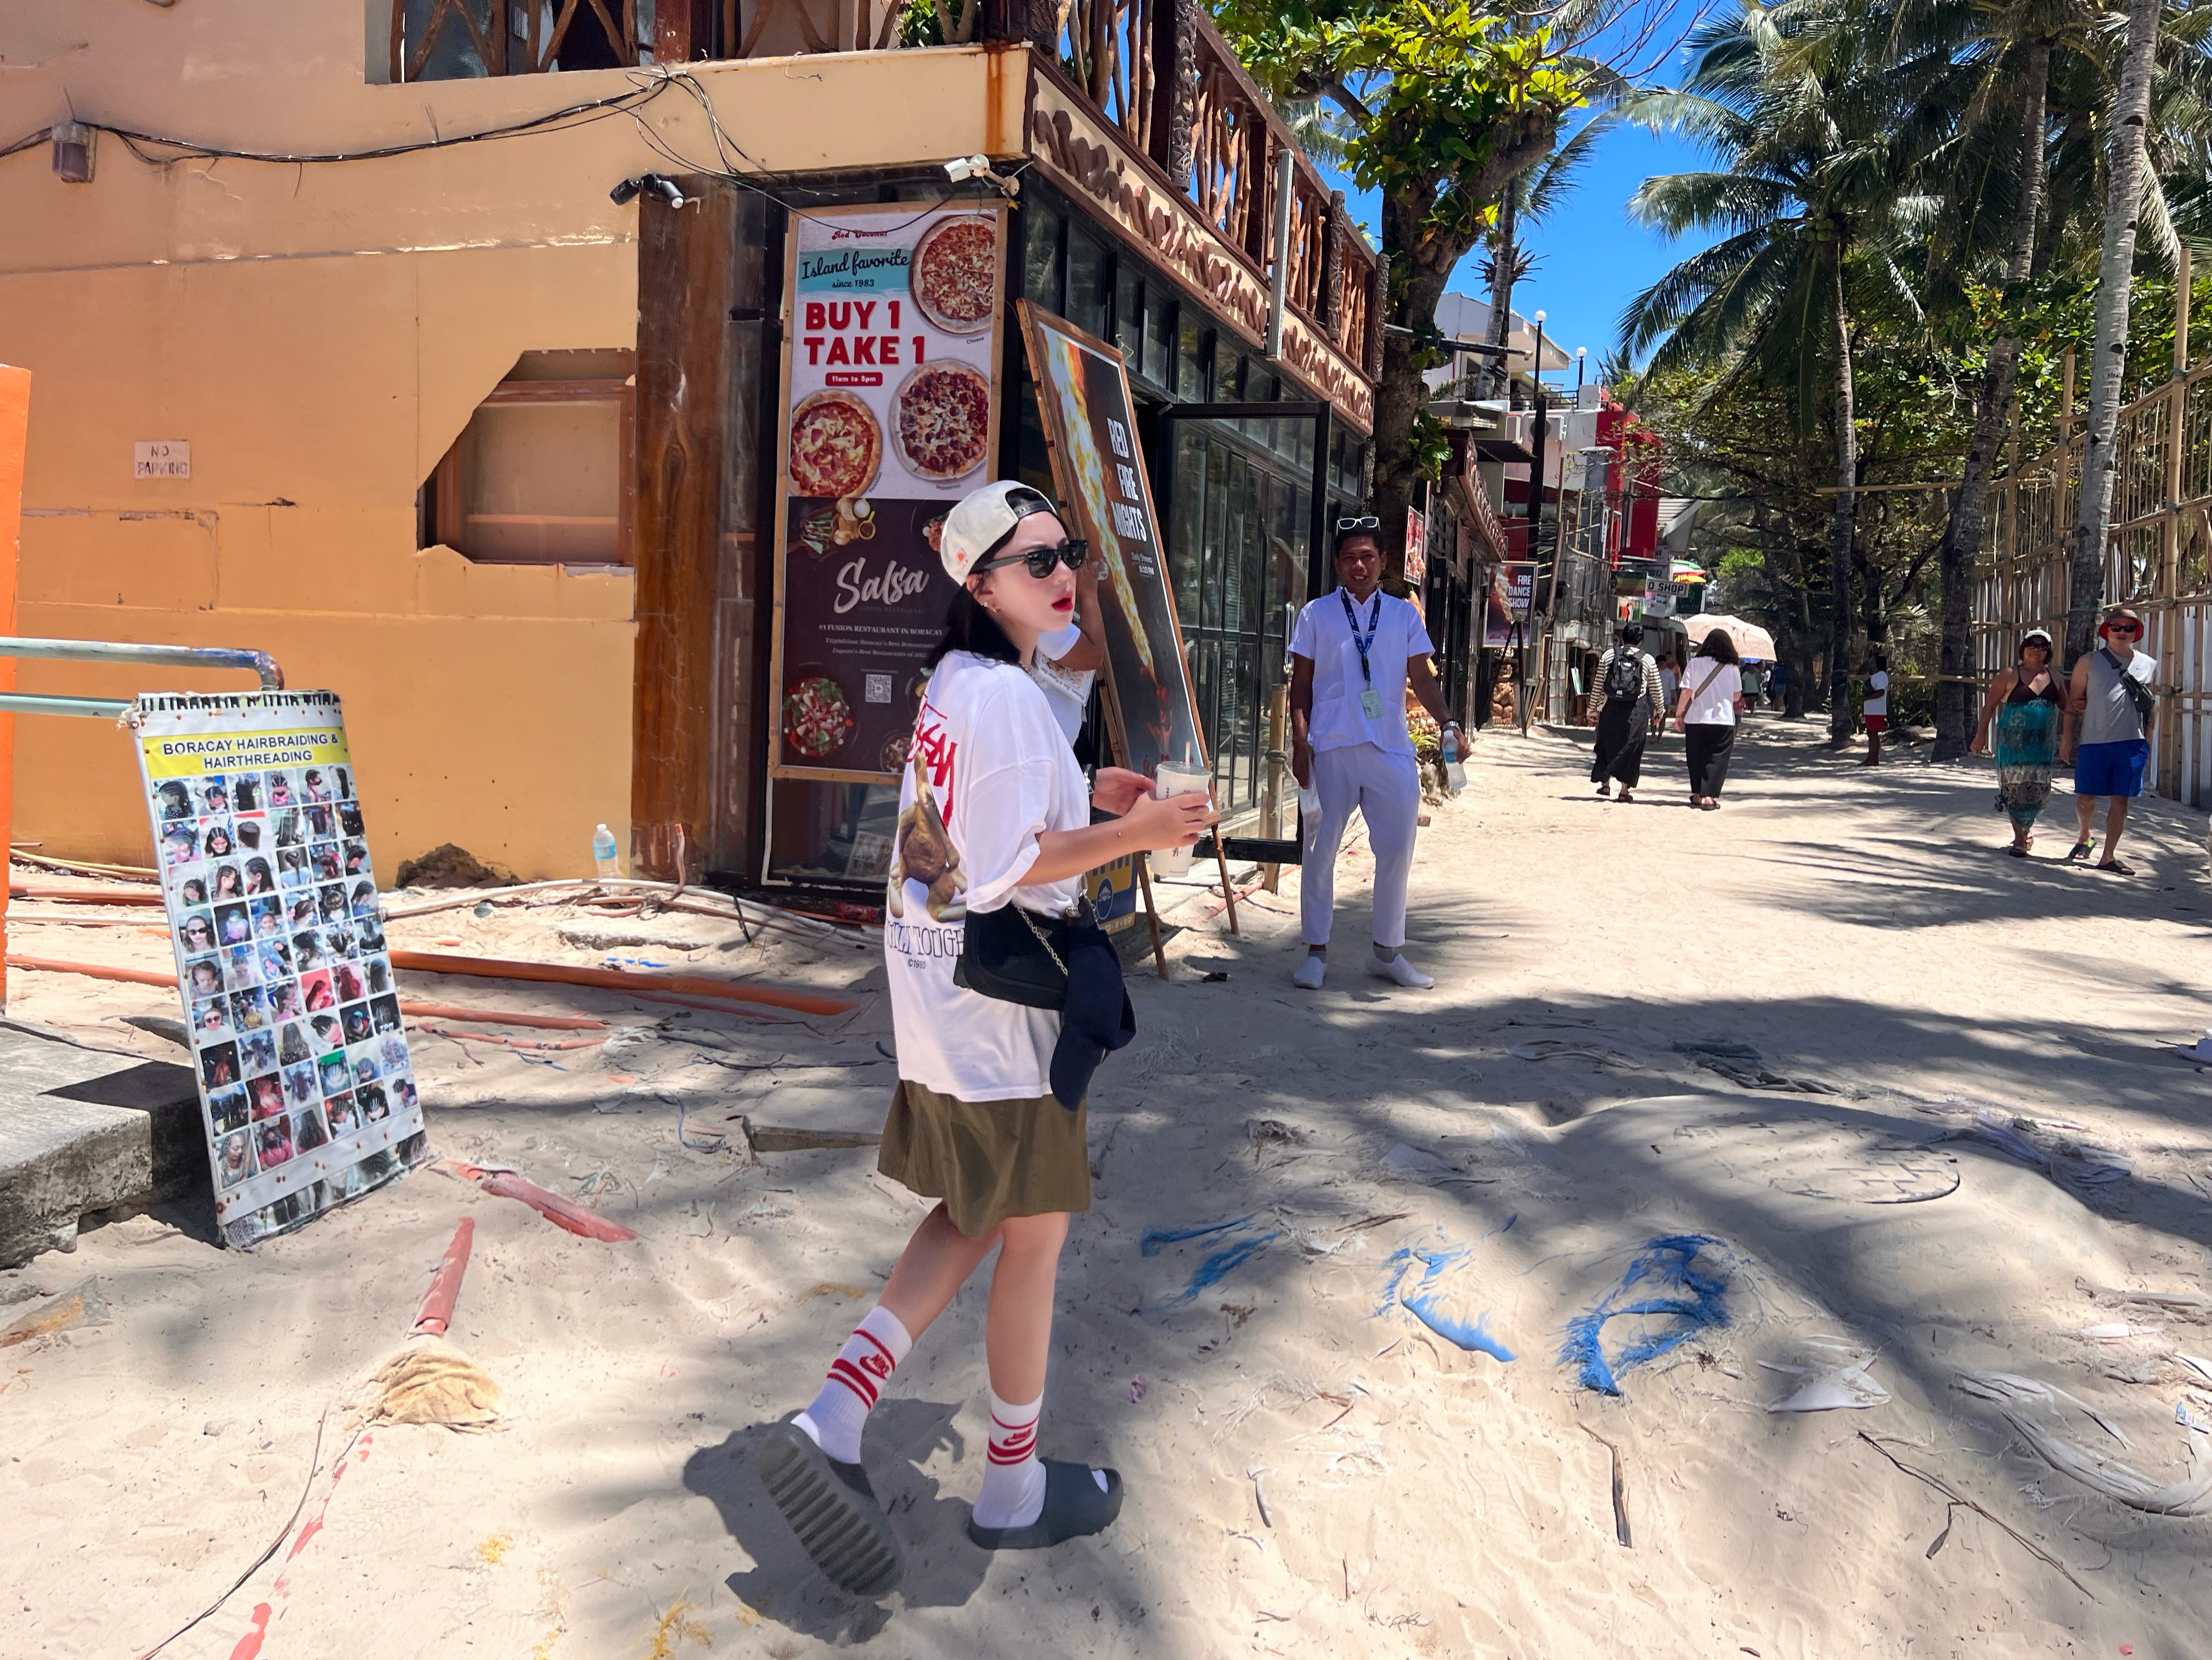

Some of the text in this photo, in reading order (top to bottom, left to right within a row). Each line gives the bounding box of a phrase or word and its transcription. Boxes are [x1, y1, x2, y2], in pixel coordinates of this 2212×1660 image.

[802, 249, 910, 280] Island favorite
[832, 279, 874, 288] since 1983
[805, 300, 900, 330] BUY 1
[966, 336, 985, 345] Cheese
[804, 336, 925, 365] TAKE 1
[861, 375, 876, 384] 5pm
[1107, 418, 1130, 459] RED
[151, 446, 170, 457] NO
[1116, 463, 1139, 501] FIRE
[1110, 501, 1147, 542] NIGHTS
[834, 556, 930, 614] Salsa
[1517, 575, 1531, 585] FIRE
[1658, 583, 1684, 593] SHOP
[1509, 586, 1531, 597] DANCE
[1509, 598, 1530, 608] SHOW
[854, 626, 899, 634] RESTAURANT
[163, 734, 338, 756] BORACAY HAIRBRAIDING &
[204, 750, 313, 769] HAIRTHREADING
[887, 918, 912, 955] UILT
